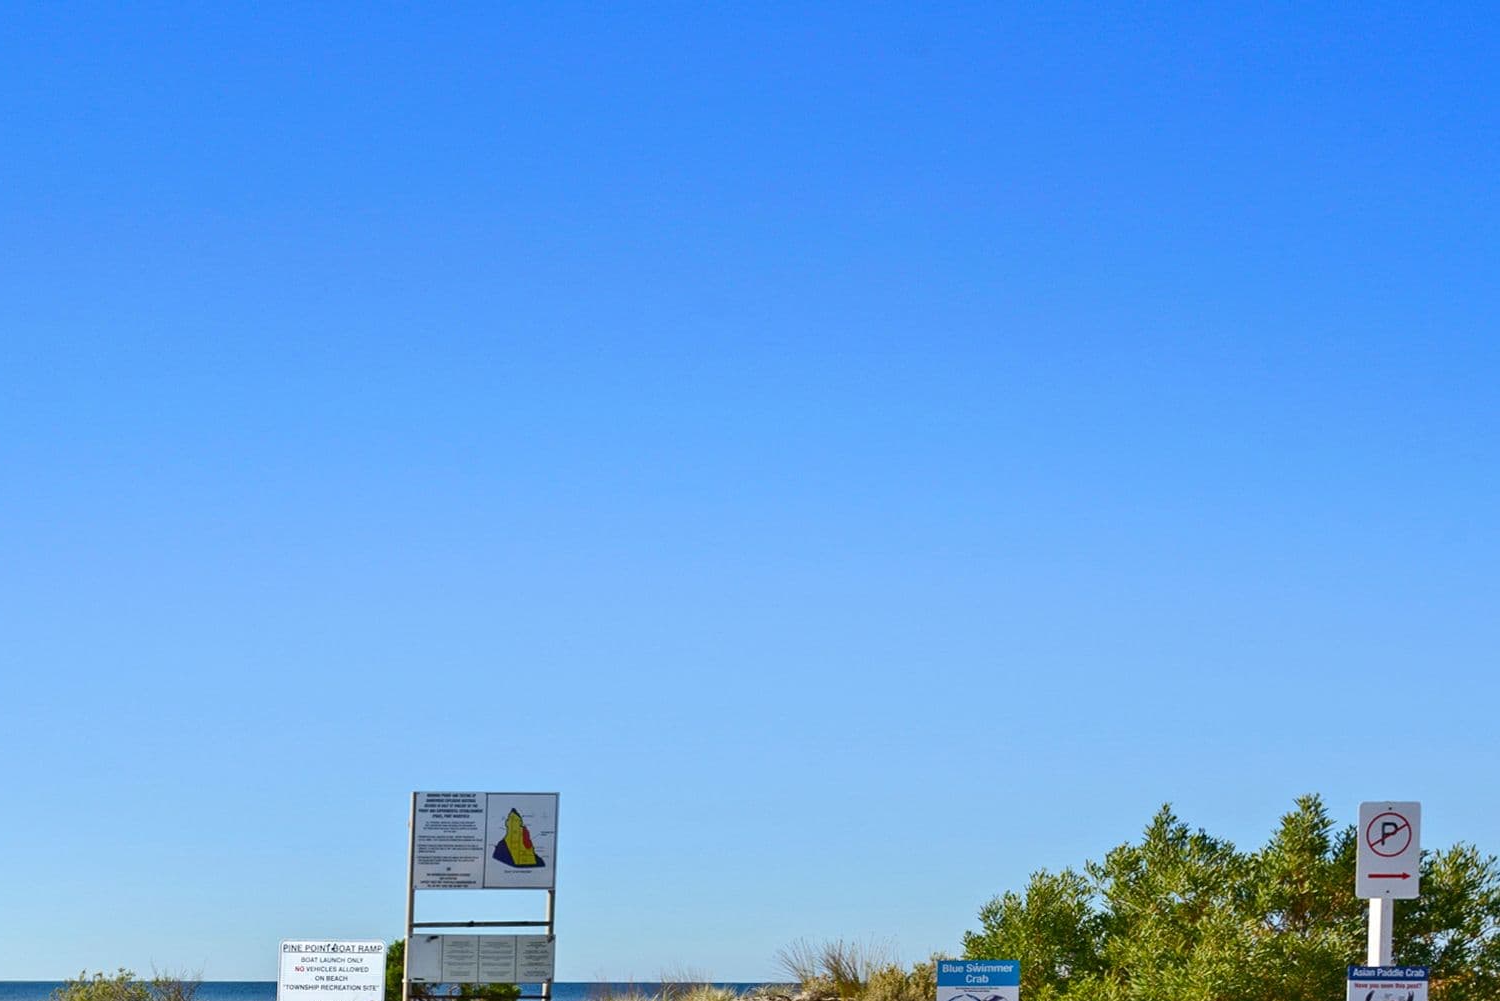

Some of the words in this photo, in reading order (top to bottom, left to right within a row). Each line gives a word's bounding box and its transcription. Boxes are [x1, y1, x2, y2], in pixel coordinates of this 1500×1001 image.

[283, 944, 302, 953] PINE
[305, 944, 331, 953] POINT
[333, 944, 357, 953] BOAT
[358, 944, 383, 953] RAMP
[942, 964, 965, 973] Blue
[966, 963, 1014, 973] Swimmer
[1353, 968, 1376, 977] Asian
[1377, 968, 1404, 977] Paddle
[1405, 968, 1426, 977] Crab
[965, 974, 990, 984] Crab
